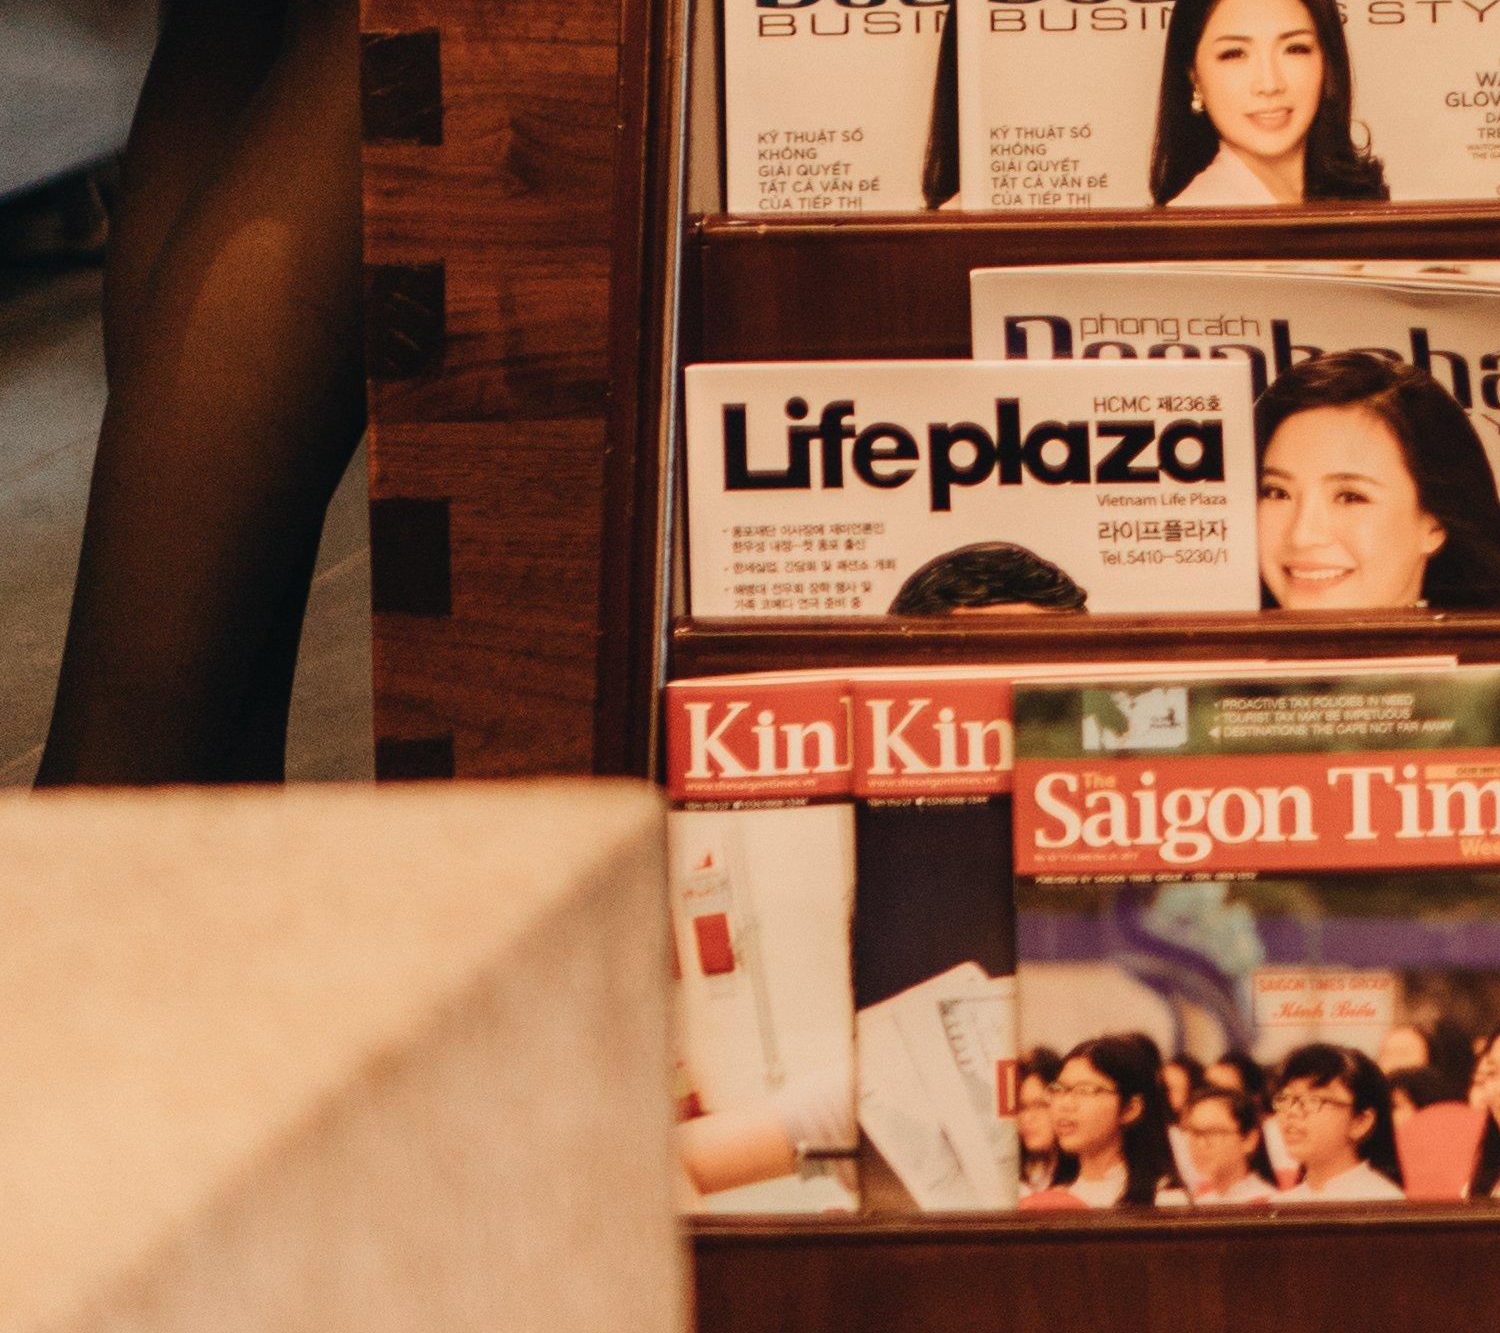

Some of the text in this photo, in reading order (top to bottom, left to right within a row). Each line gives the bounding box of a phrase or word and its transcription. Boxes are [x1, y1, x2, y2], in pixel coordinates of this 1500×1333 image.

[757, 145, 818, 161] KHÔNG
[990, 142, 1048, 158] KHÔNG
[1080, 314, 1180, 342] phong
[1188, 314, 1260, 337] cách
[1094, 396, 1151, 413] HCMC
[1096, 492, 1227, 507] Vietnam Life Plaza
[1098, 519, 1228, 543] 라이프플라자
[1222, 698, 1288, 710] PROACTIVE
[1290, 697, 1309, 708] TAX
[684, 777, 817, 792] www.thesaigontimes.vn
[867, 775, 998, 789] www.thesaigontimes.vn
[1081, 771, 1117, 792] The
[1033, 771, 1320, 865] Saigon
